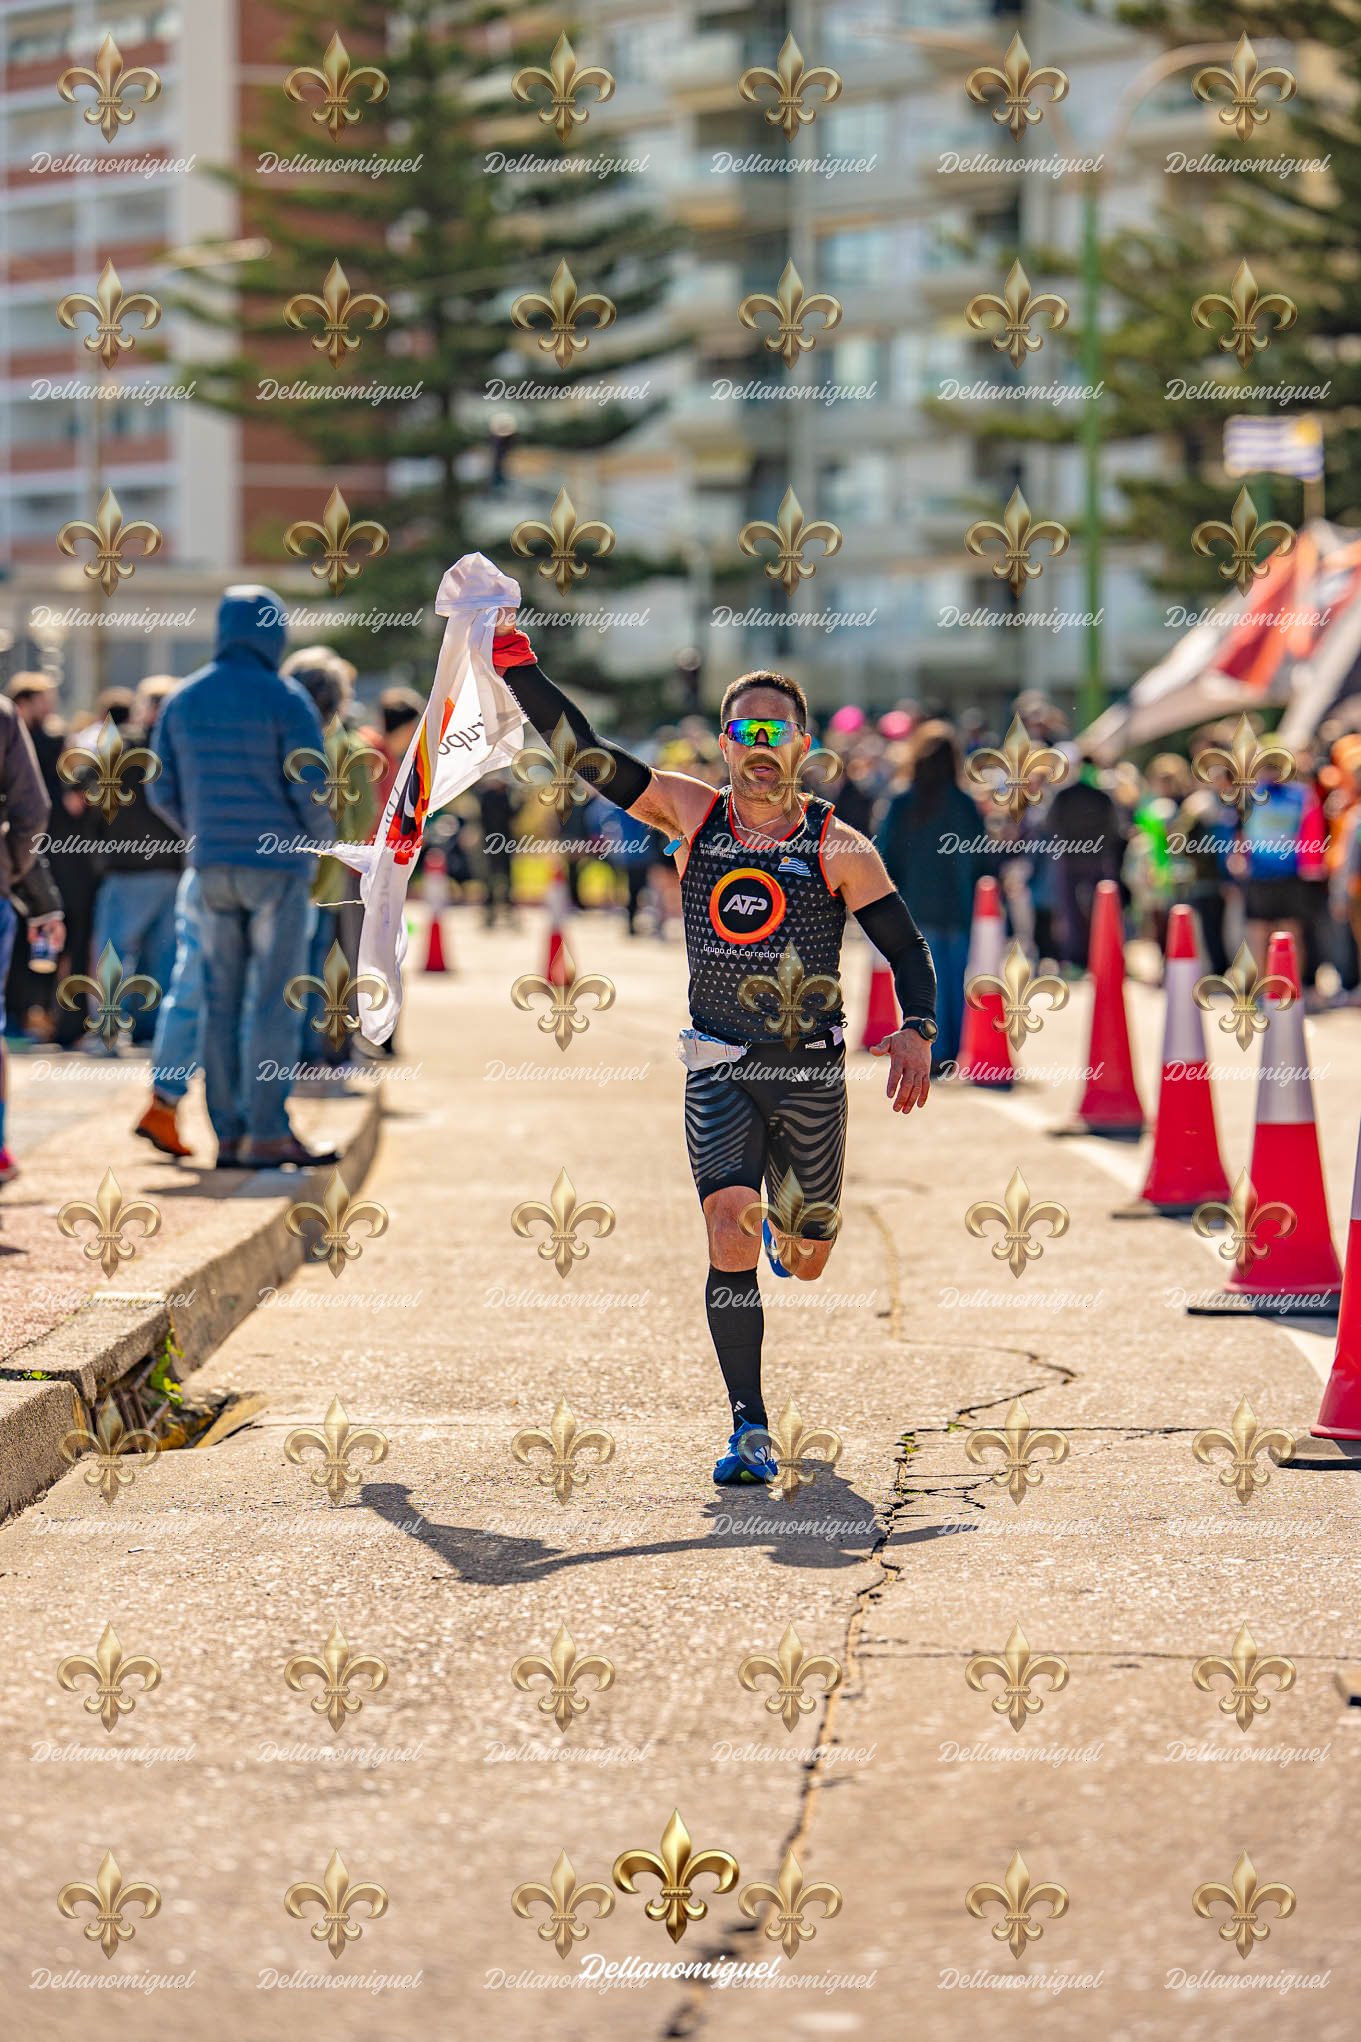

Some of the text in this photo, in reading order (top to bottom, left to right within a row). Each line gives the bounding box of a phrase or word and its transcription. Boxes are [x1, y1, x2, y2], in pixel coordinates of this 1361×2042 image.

[722, 894, 768, 915] ATP
[703, 943, 791, 959] Grupo de Corredores
